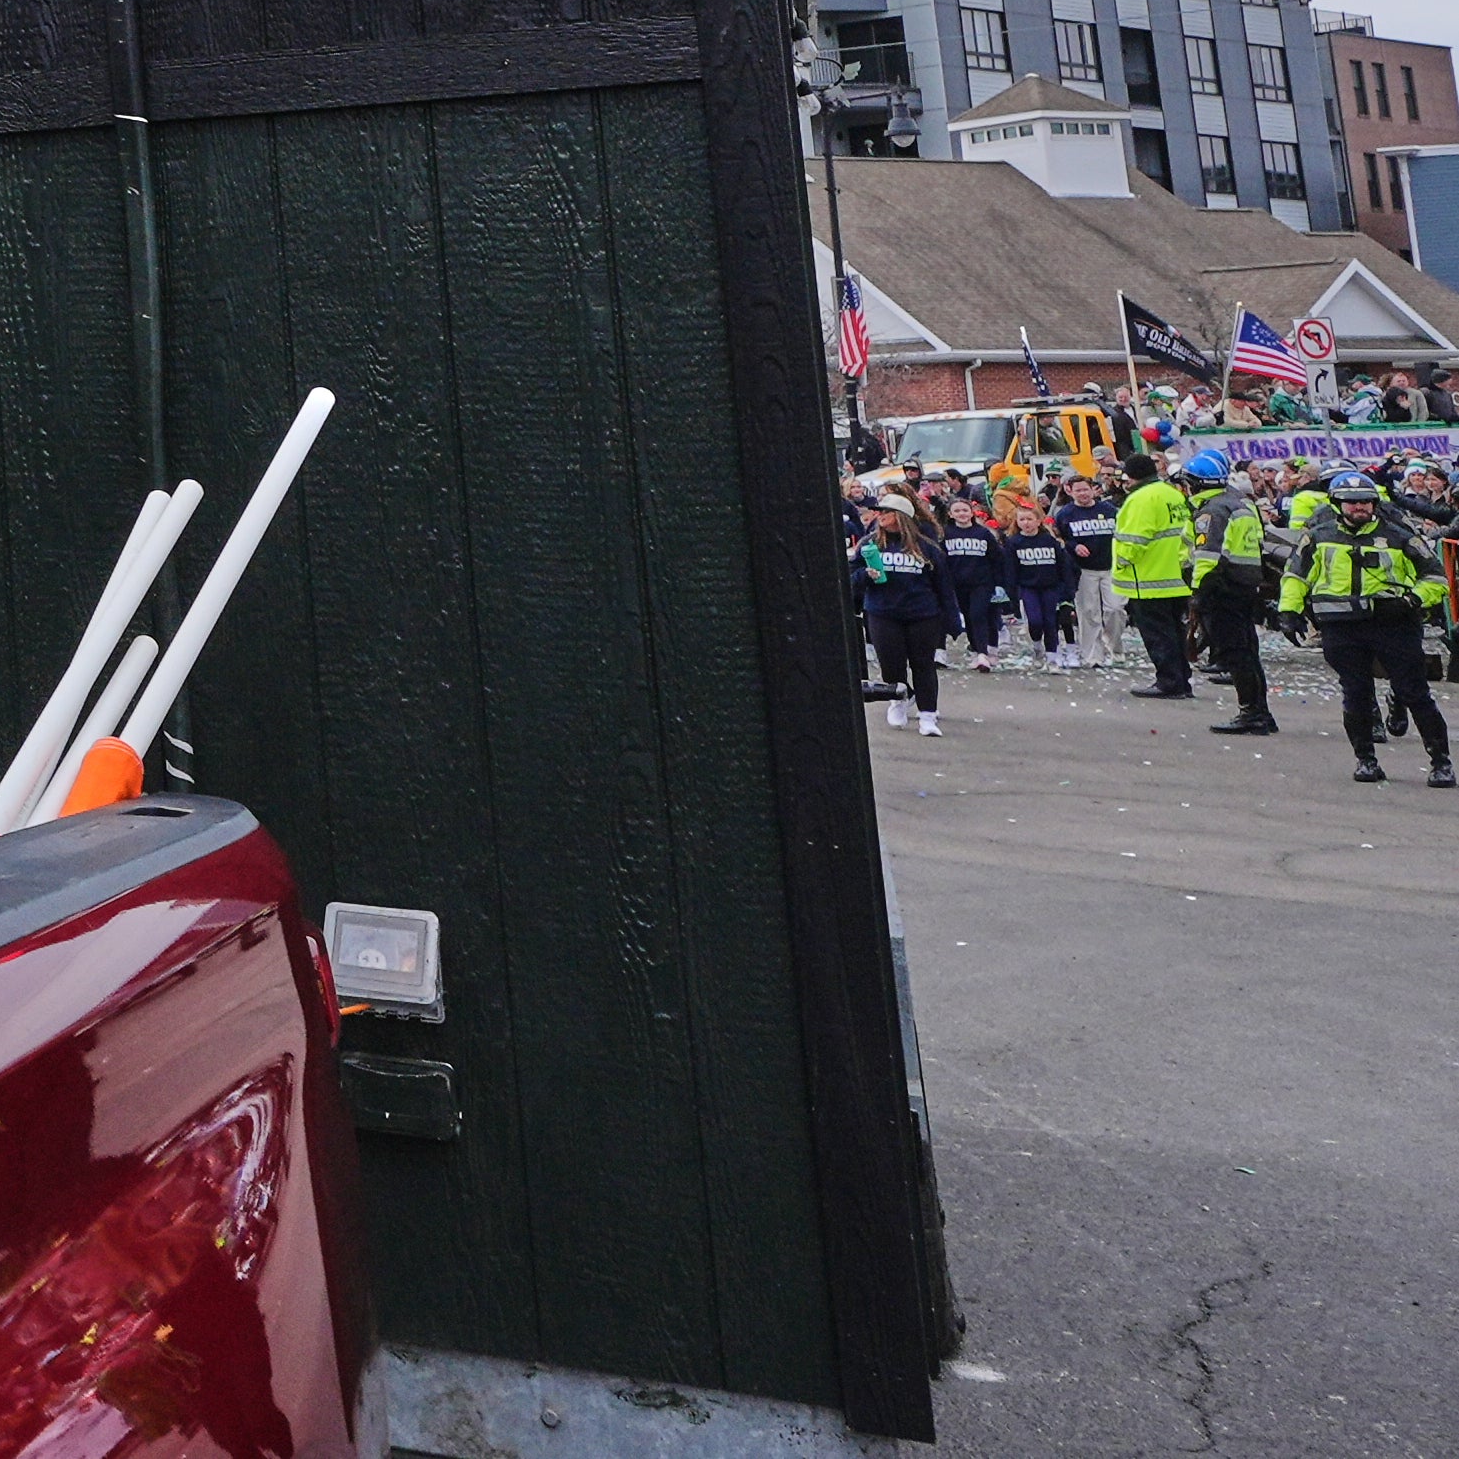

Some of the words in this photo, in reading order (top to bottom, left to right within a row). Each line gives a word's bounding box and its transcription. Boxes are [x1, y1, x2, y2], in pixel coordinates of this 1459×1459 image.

[1150, 328, 1170, 347] OLD
[1314, 395, 1335, 405] ONLY
[1227, 437, 1290, 461] FLAGS
[1293, 436, 1343, 458] OVER
[1069, 518, 1115, 532] WOODS
[945, 538, 987, 551] WOODS
[880, 552, 925, 568] OODS
